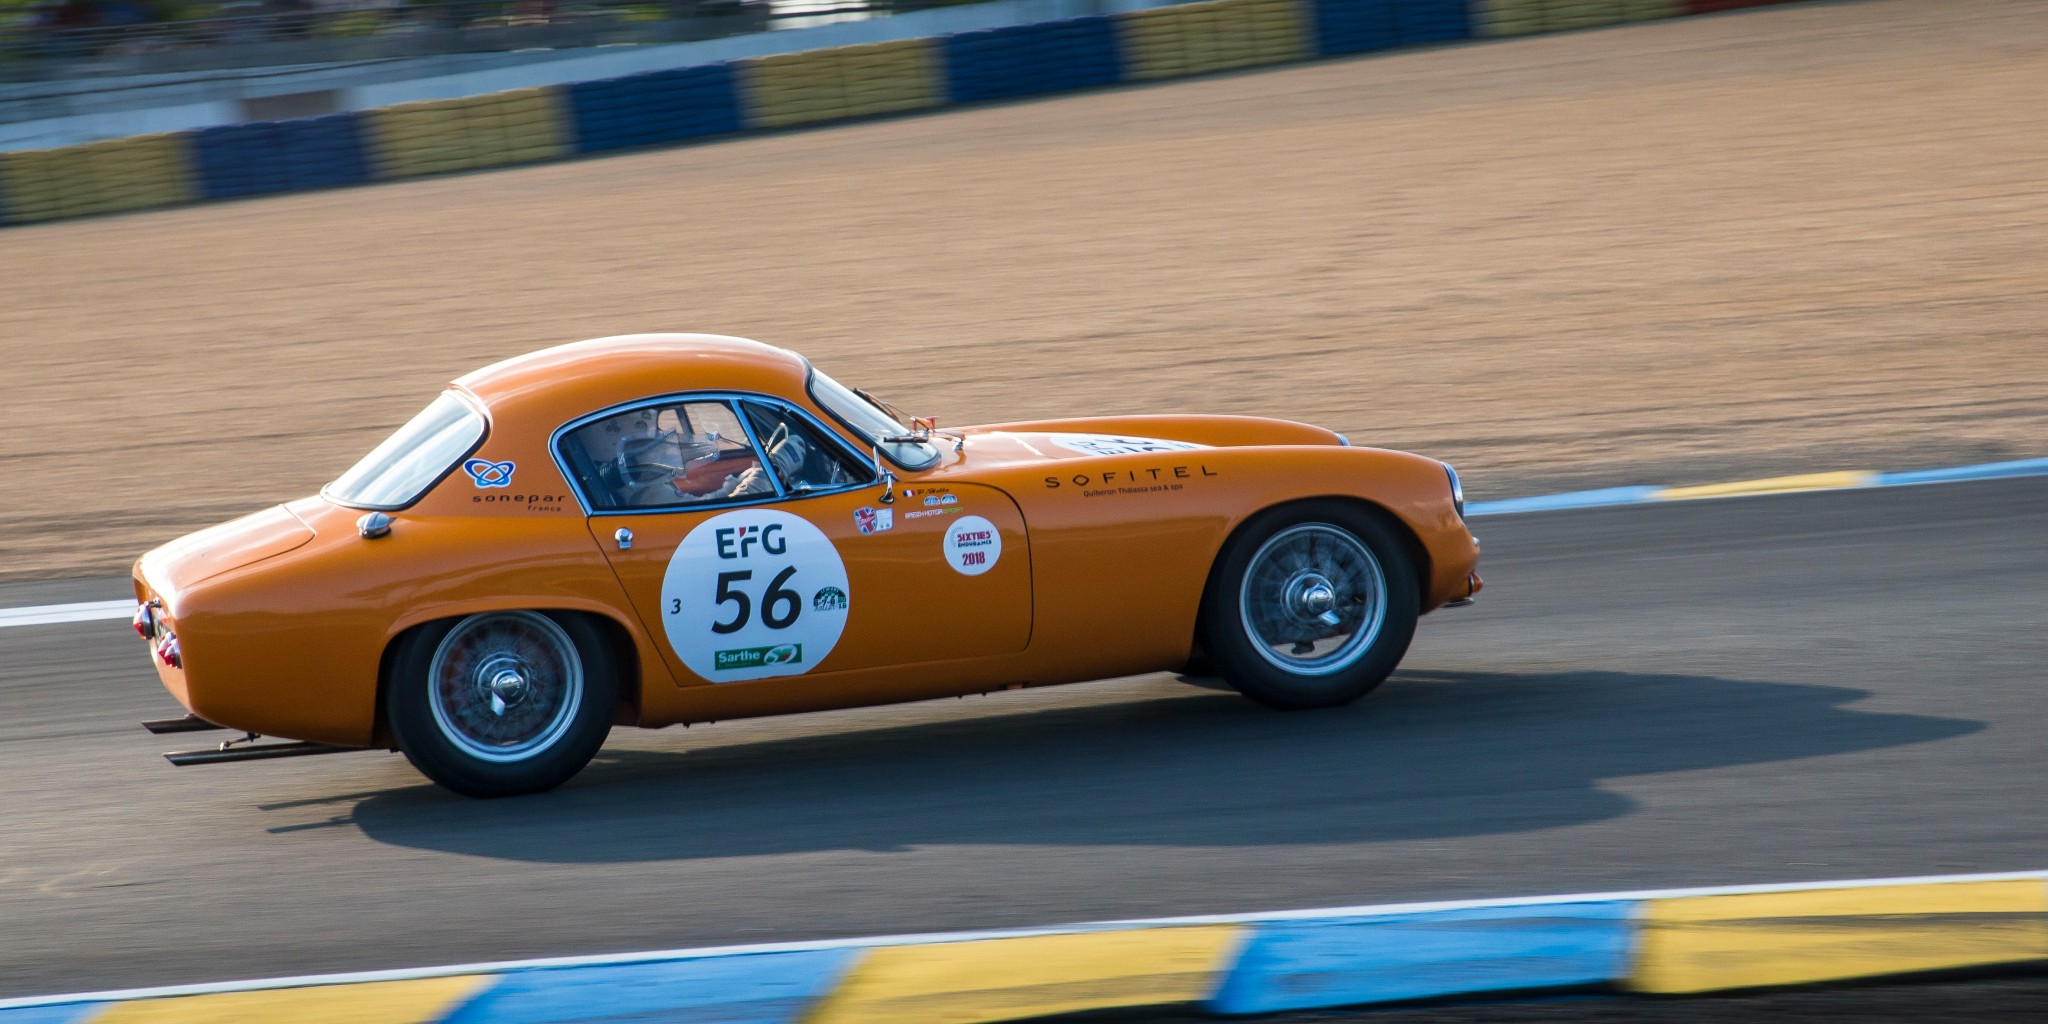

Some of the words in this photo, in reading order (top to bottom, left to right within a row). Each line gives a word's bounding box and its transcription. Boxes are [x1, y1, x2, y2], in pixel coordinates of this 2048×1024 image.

[1045, 465, 1218, 488] SOFITEL
[1083, 489, 1117, 498] Quiberon
[1118, 486, 1148, 495] Thalassa
[1170, 483, 1183, 492] spa
[472, 494, 566, 504] sonepar
[715, 523, 787, 559] EFG
[958, 540, 992, 548] ENDURANCE
[962, 551, 986, 567] 2018
[671, 598, 682, 615] 3
[711, 565, 802, 634] 56
[718, 650, 761, 663] Sarthe
